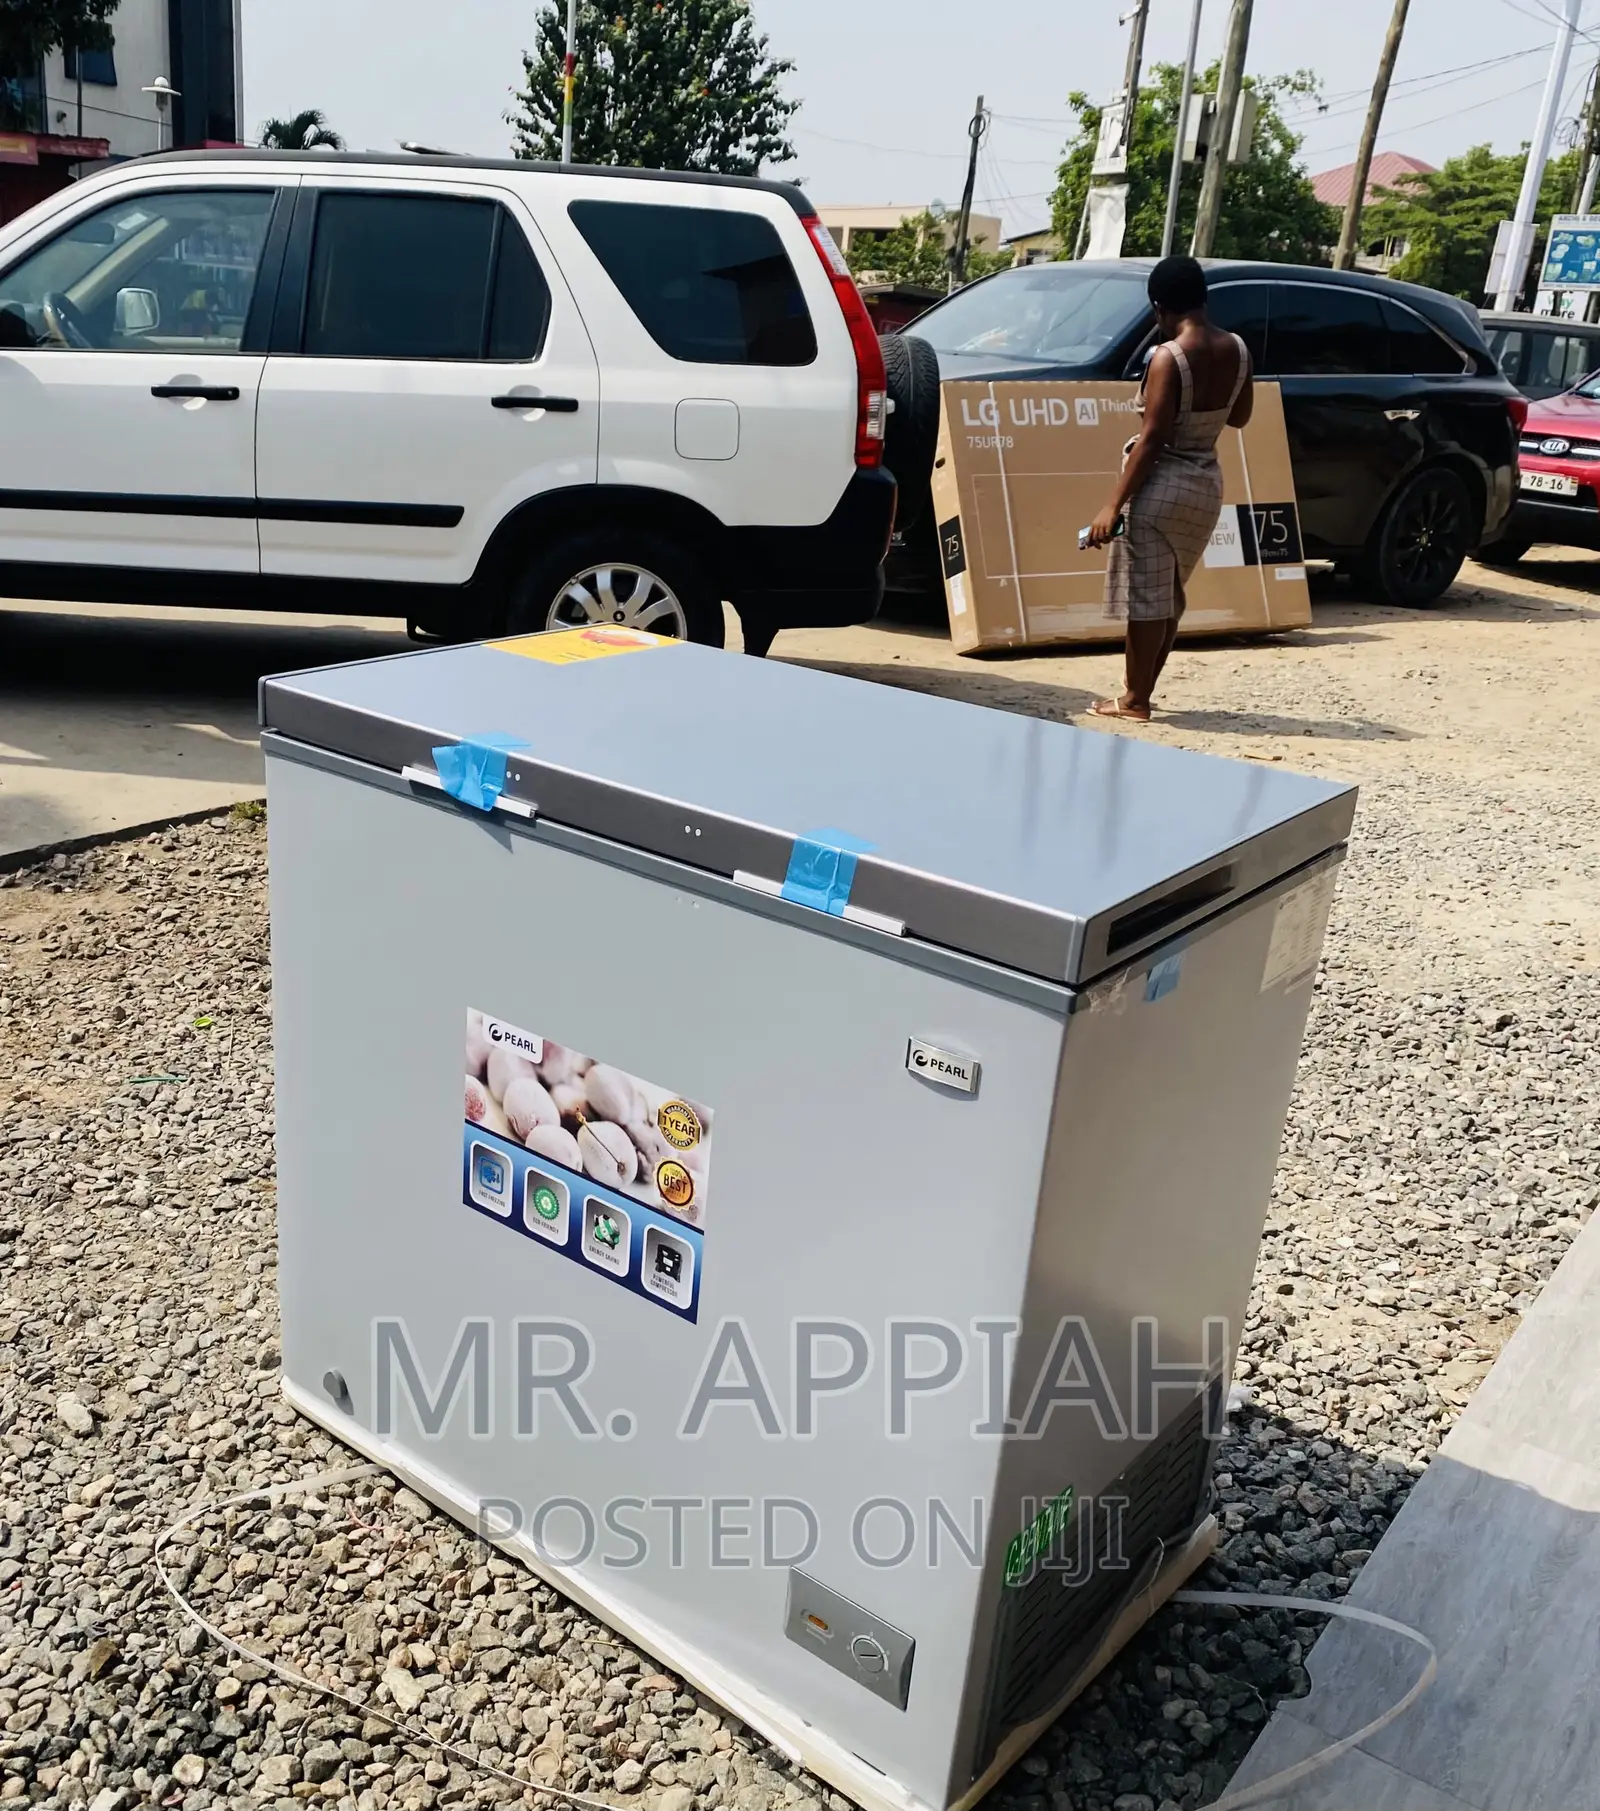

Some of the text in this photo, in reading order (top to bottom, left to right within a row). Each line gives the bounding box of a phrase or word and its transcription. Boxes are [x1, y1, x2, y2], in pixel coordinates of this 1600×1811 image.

[1541, 309, 1575, 319] mre
[961, 399, 1000, 426] LG
[1009, 398, 1069, 426] UHD
[1078, 402, 1097, 421] AI
[1248, 510, 1288, 544] 75
[944, 534, 959, 556] 75
[504, 1031, 536, 1054] PEARL
[930, 1058, 969, 1080] PEARL
[662, 1115, 696, 1138] 1 YEAR
[663, 1173, 687, 1194] BEST
